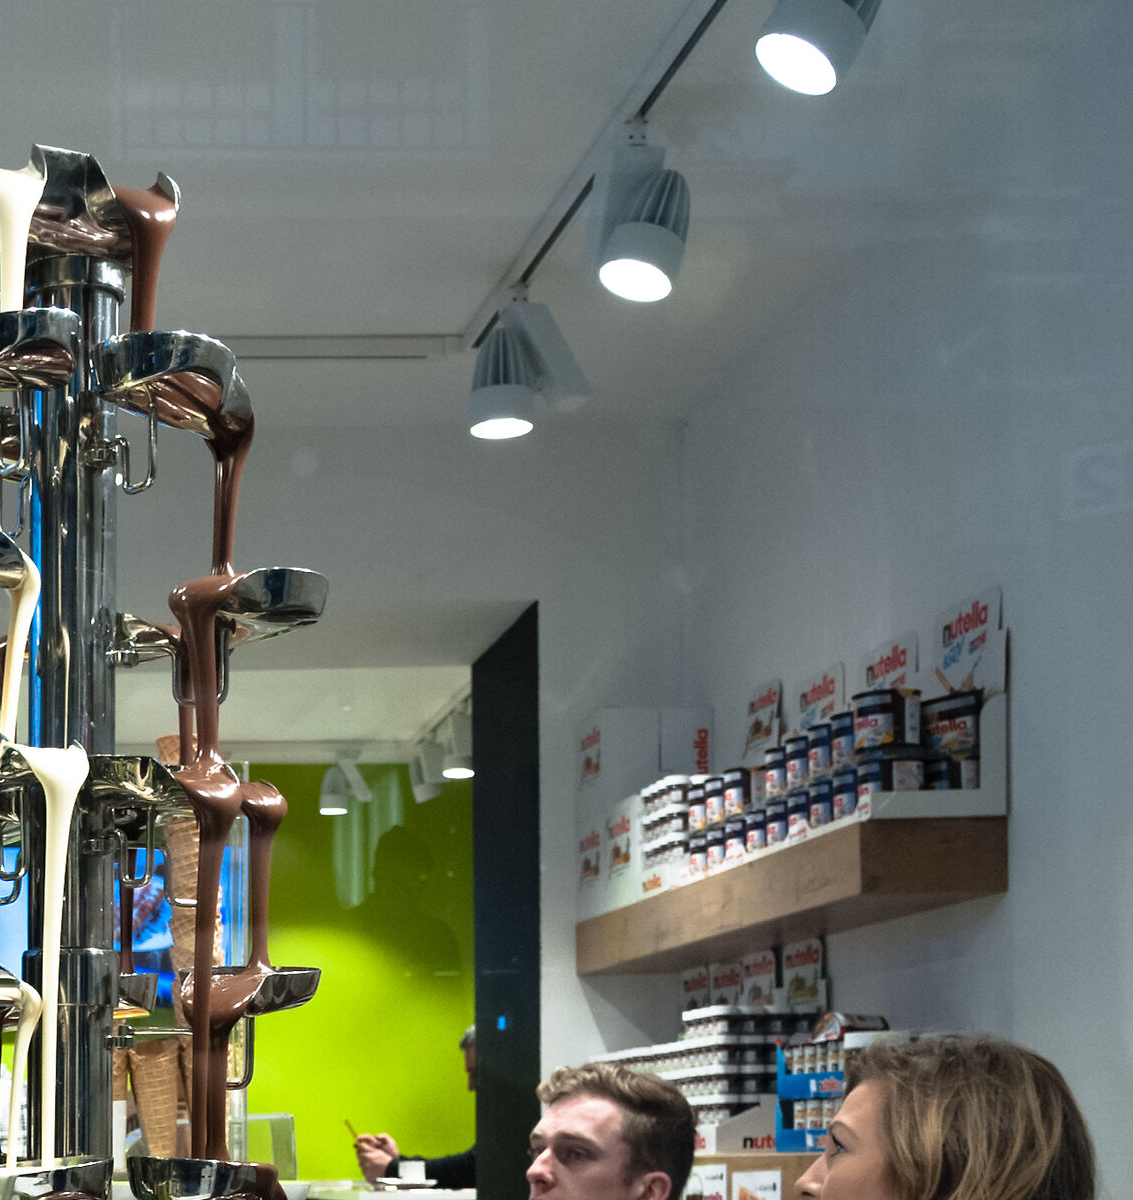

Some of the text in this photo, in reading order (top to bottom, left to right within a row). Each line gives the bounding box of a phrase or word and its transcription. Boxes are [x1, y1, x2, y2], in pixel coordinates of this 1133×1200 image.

[942, 600, 989, 648] nutella
[867, 644, 907, 688] nutella
[800, 674, 835, 712] nutella
[784, 943, 819, 969] nutella
[743, 1134, 776, 1150] nut
